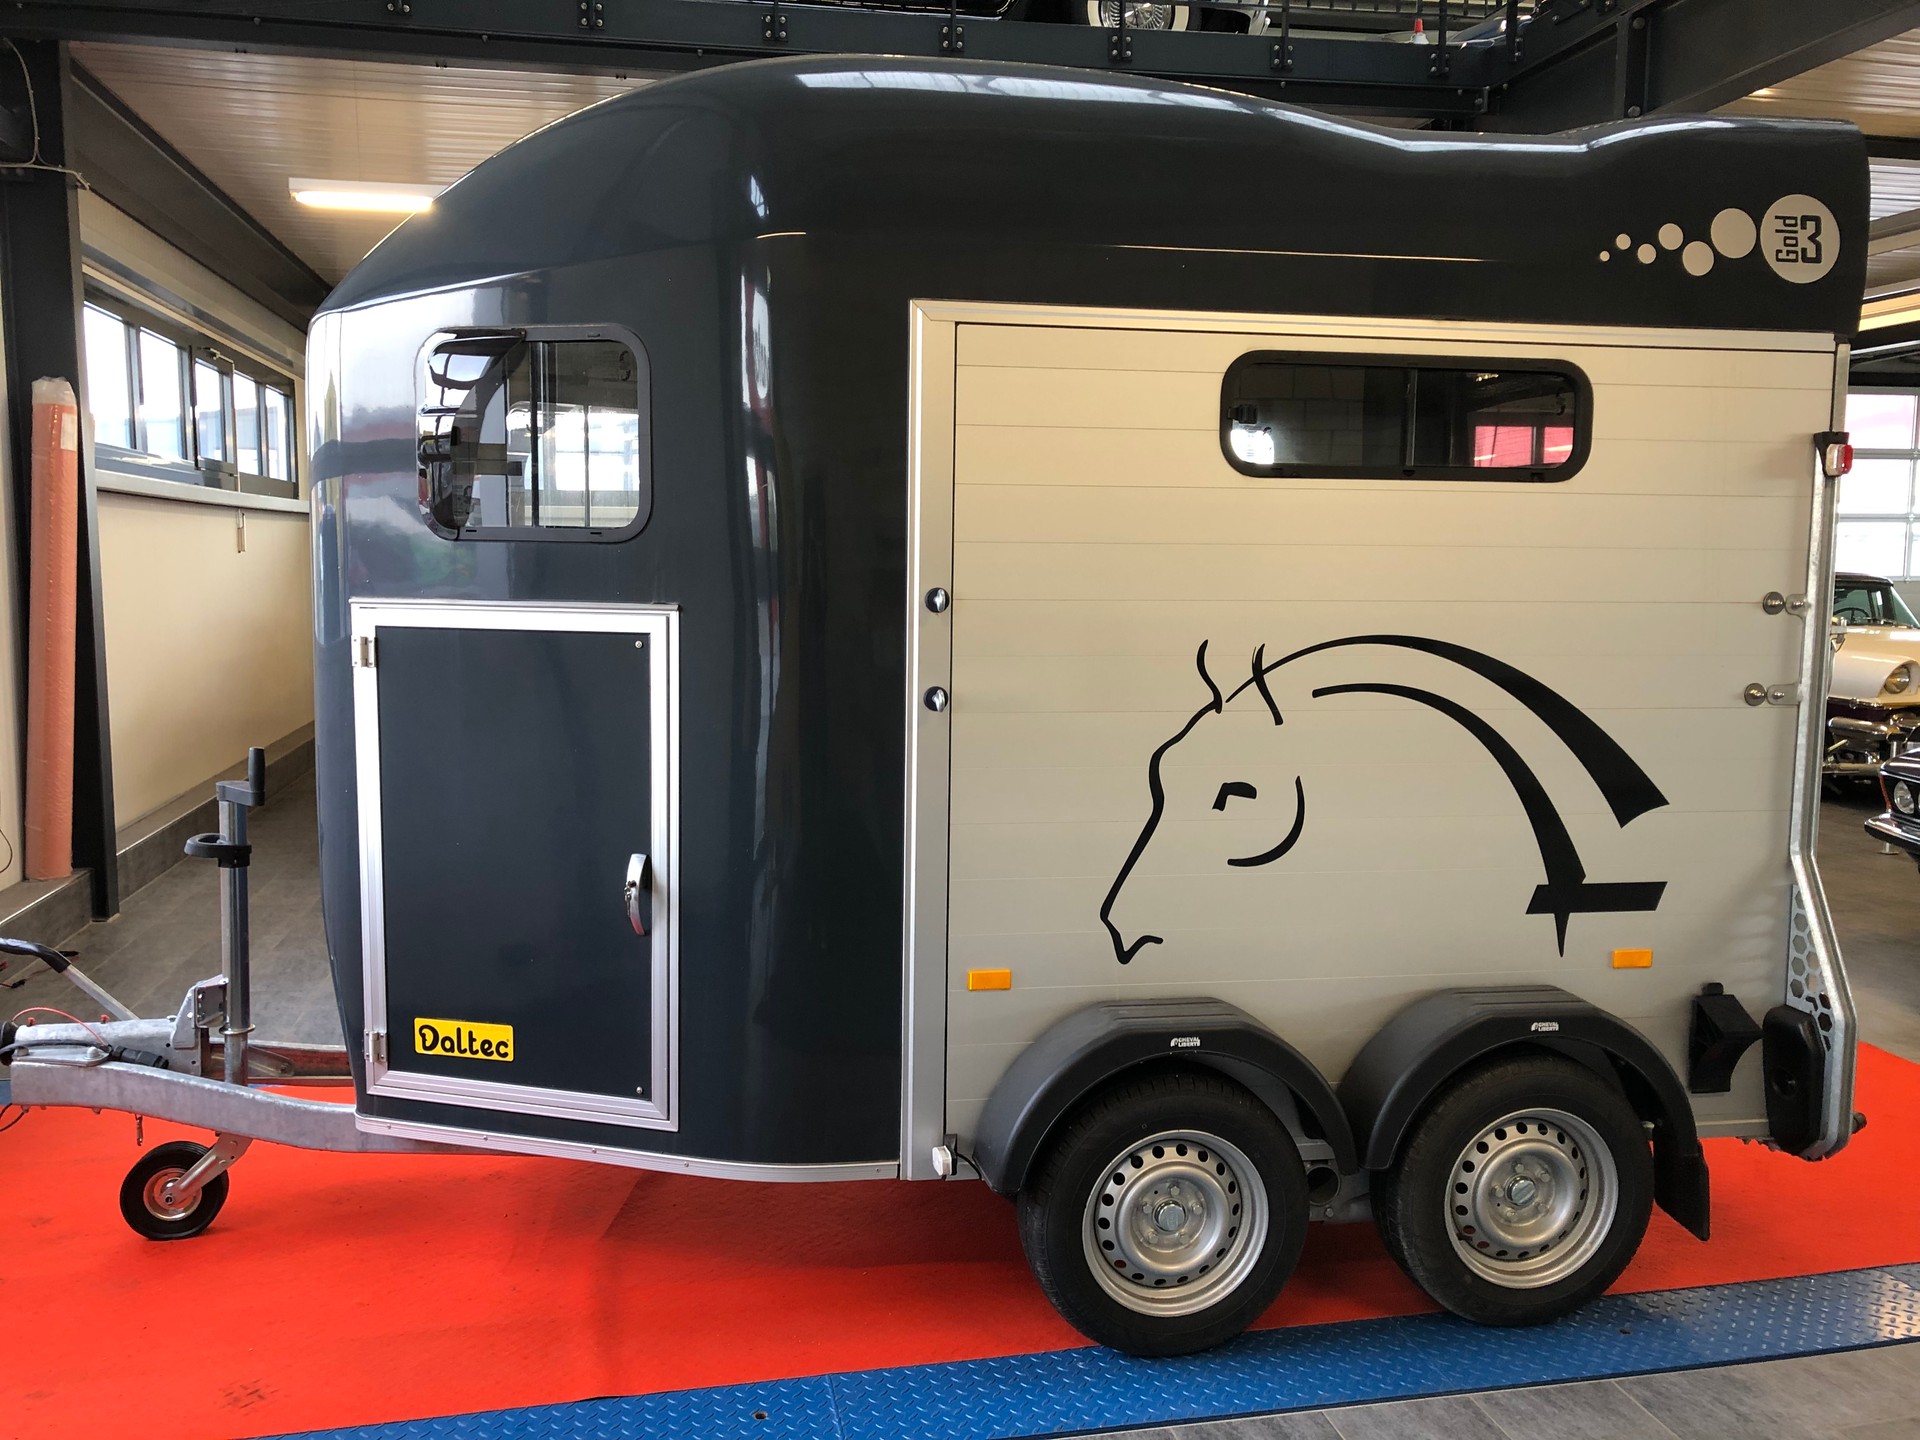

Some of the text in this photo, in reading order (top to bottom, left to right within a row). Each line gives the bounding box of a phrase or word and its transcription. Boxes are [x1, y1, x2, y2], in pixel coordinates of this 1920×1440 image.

[1774, 215, 1799, 263] Gold
[1800, 214, 1822, 264] 3
[418, 1024, 509, 1058] Daltec
